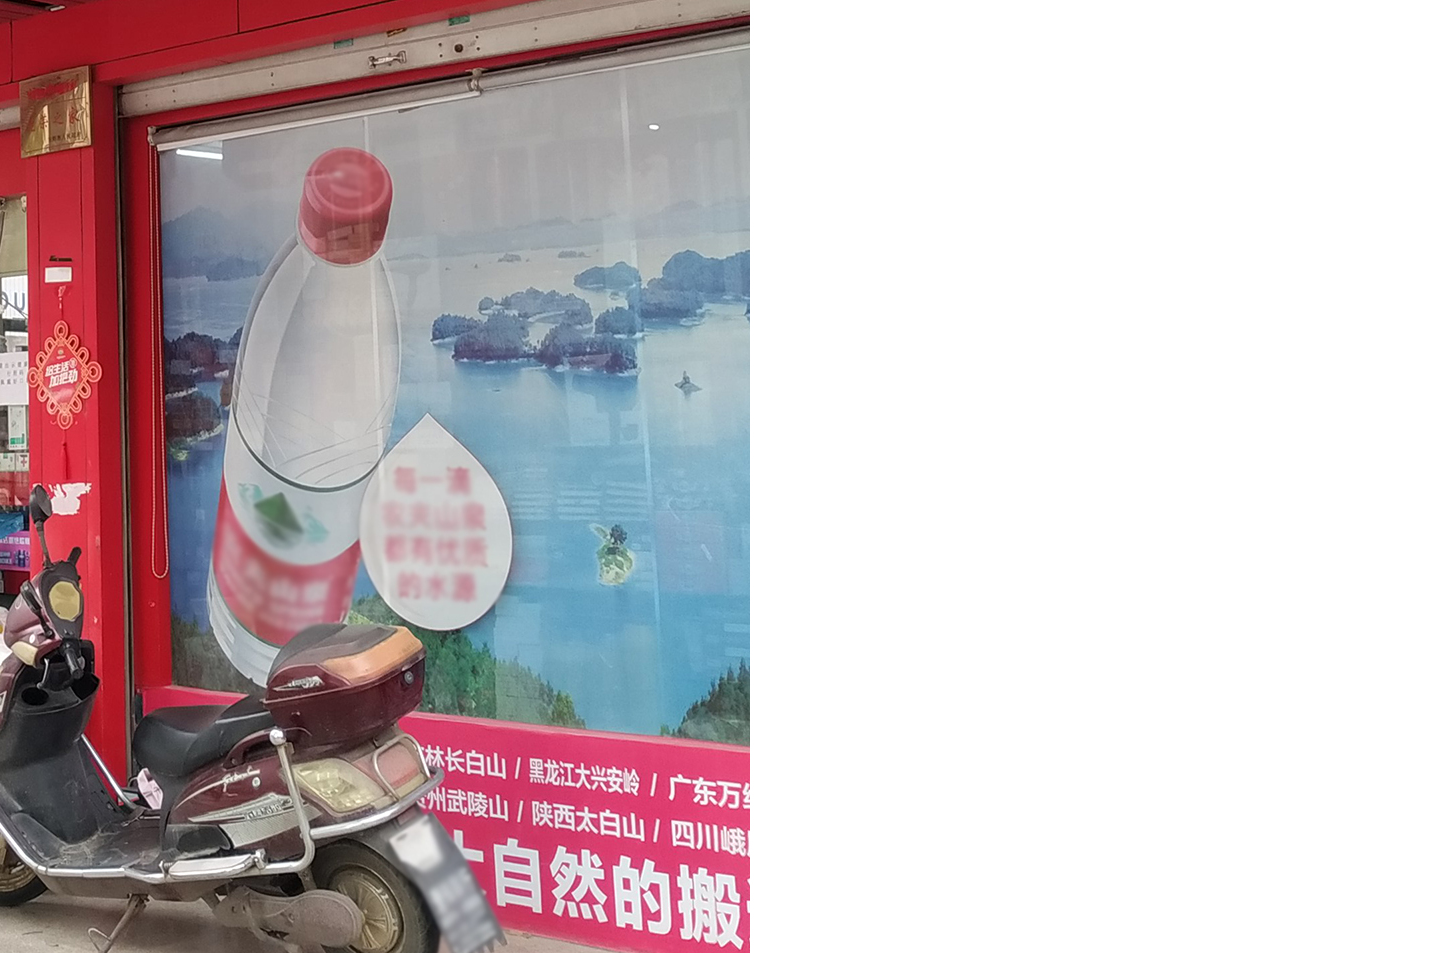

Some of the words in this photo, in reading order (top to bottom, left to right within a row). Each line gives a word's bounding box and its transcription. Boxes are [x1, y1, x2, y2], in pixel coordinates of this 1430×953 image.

[421, 744, 507, 780] 林长白山
[529, 757, 641, 797] 黑龙江大兴安岭
[531, 800, 647, 842] 陕西太白山
[670, 820, 750, 859] 四川峨
[452, 829, 750, 951] 自然的搬
